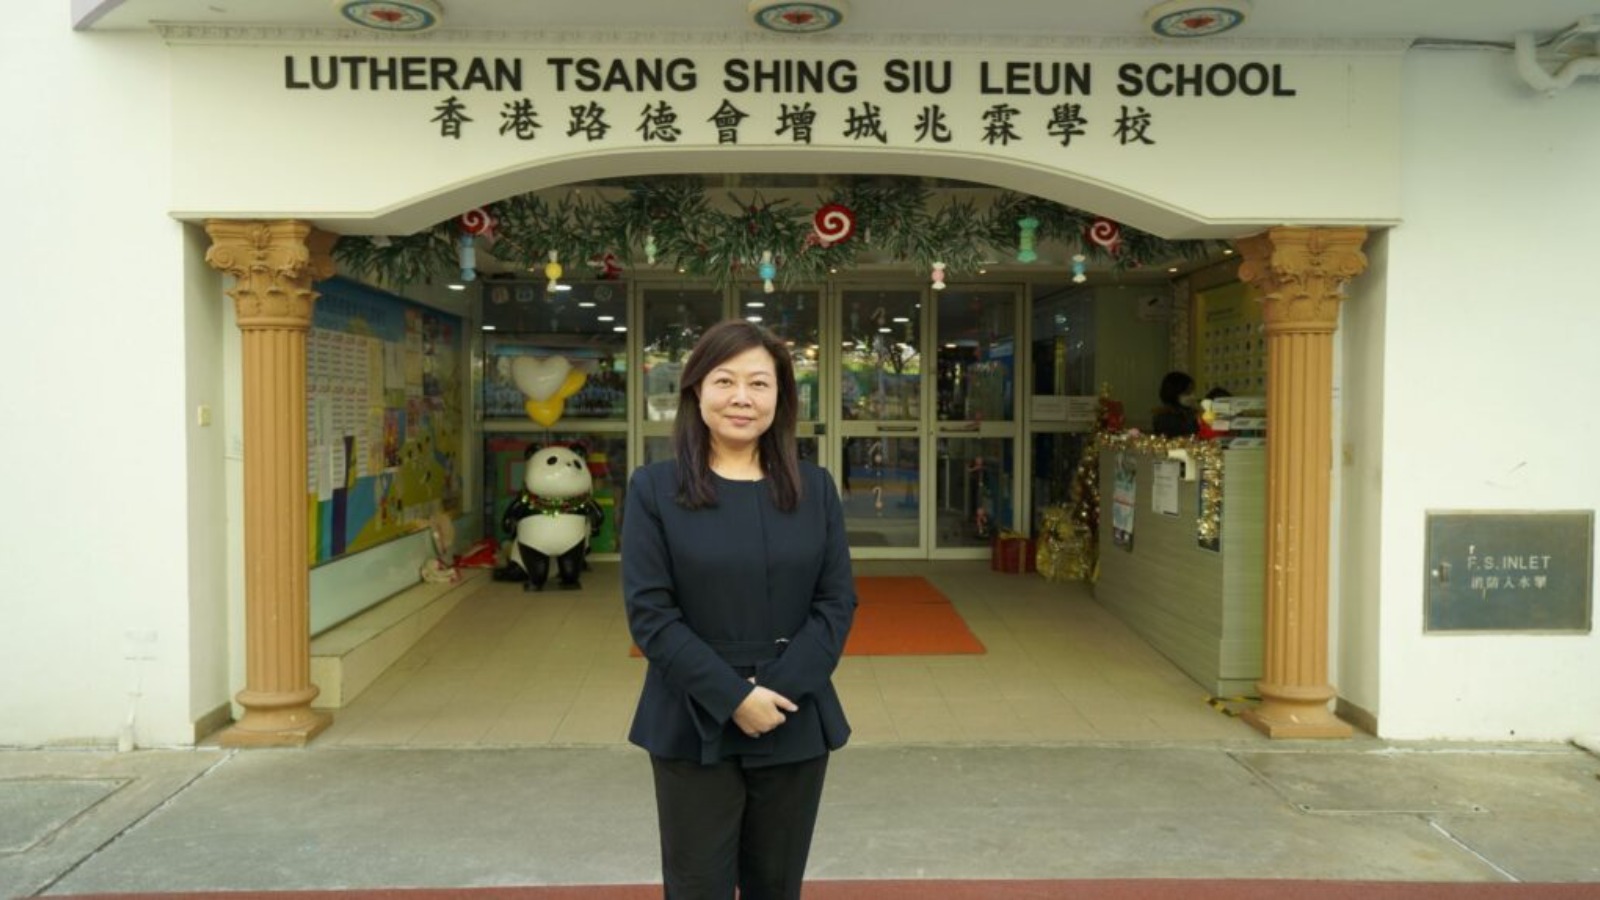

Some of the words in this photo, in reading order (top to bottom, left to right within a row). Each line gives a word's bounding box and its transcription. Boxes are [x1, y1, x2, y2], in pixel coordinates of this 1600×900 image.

[285, 56, 521, 91] LUTHERAN
[547, 58, 697, 92] TSANG
[724, 58, 857, 93] SHING
[884, 59, 951, 94] SIU
[981, 61, 1091, 96] LEUN
[1117, 62, 1296, 97] SCHOOL
[431, 97, 1155, 146] 香港路德會增城兆霖學校
